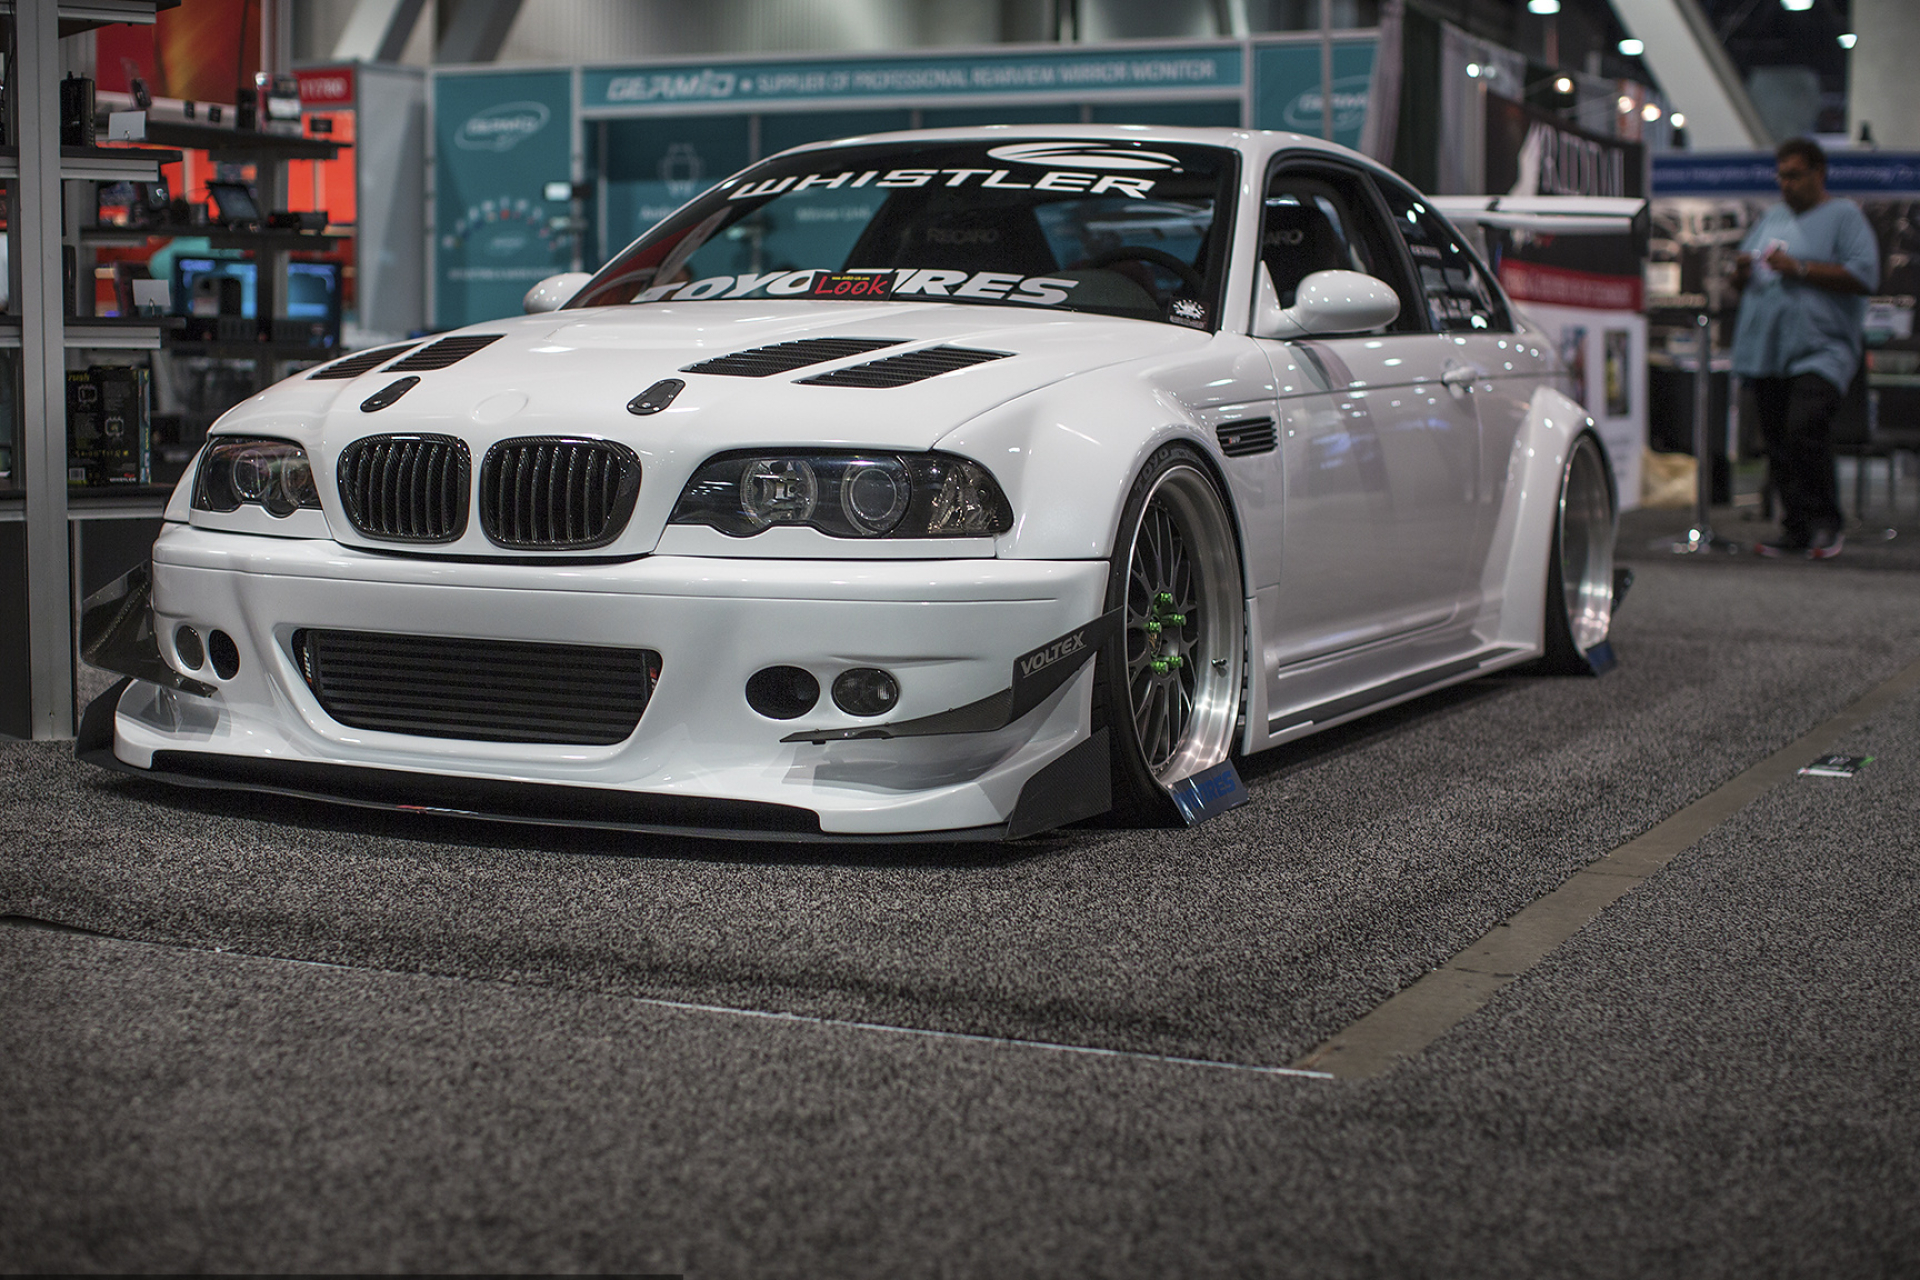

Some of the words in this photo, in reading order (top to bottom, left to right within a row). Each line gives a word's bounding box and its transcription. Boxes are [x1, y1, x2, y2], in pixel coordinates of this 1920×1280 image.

[852, 68, 967, 91] PROFESSIONAL
[1130, 59, 1217, 82] MONITOR
[728, 168, 1157, 200] WHISTLER
[926, 226, 1000, 245] RECARO
[814, 273, 888, 296] Look
[846, 268, 1080, 306] IRES
[1133, 446, 1171, 493] TOYO
[1019, 630, 1087, 677] VOLTEX
